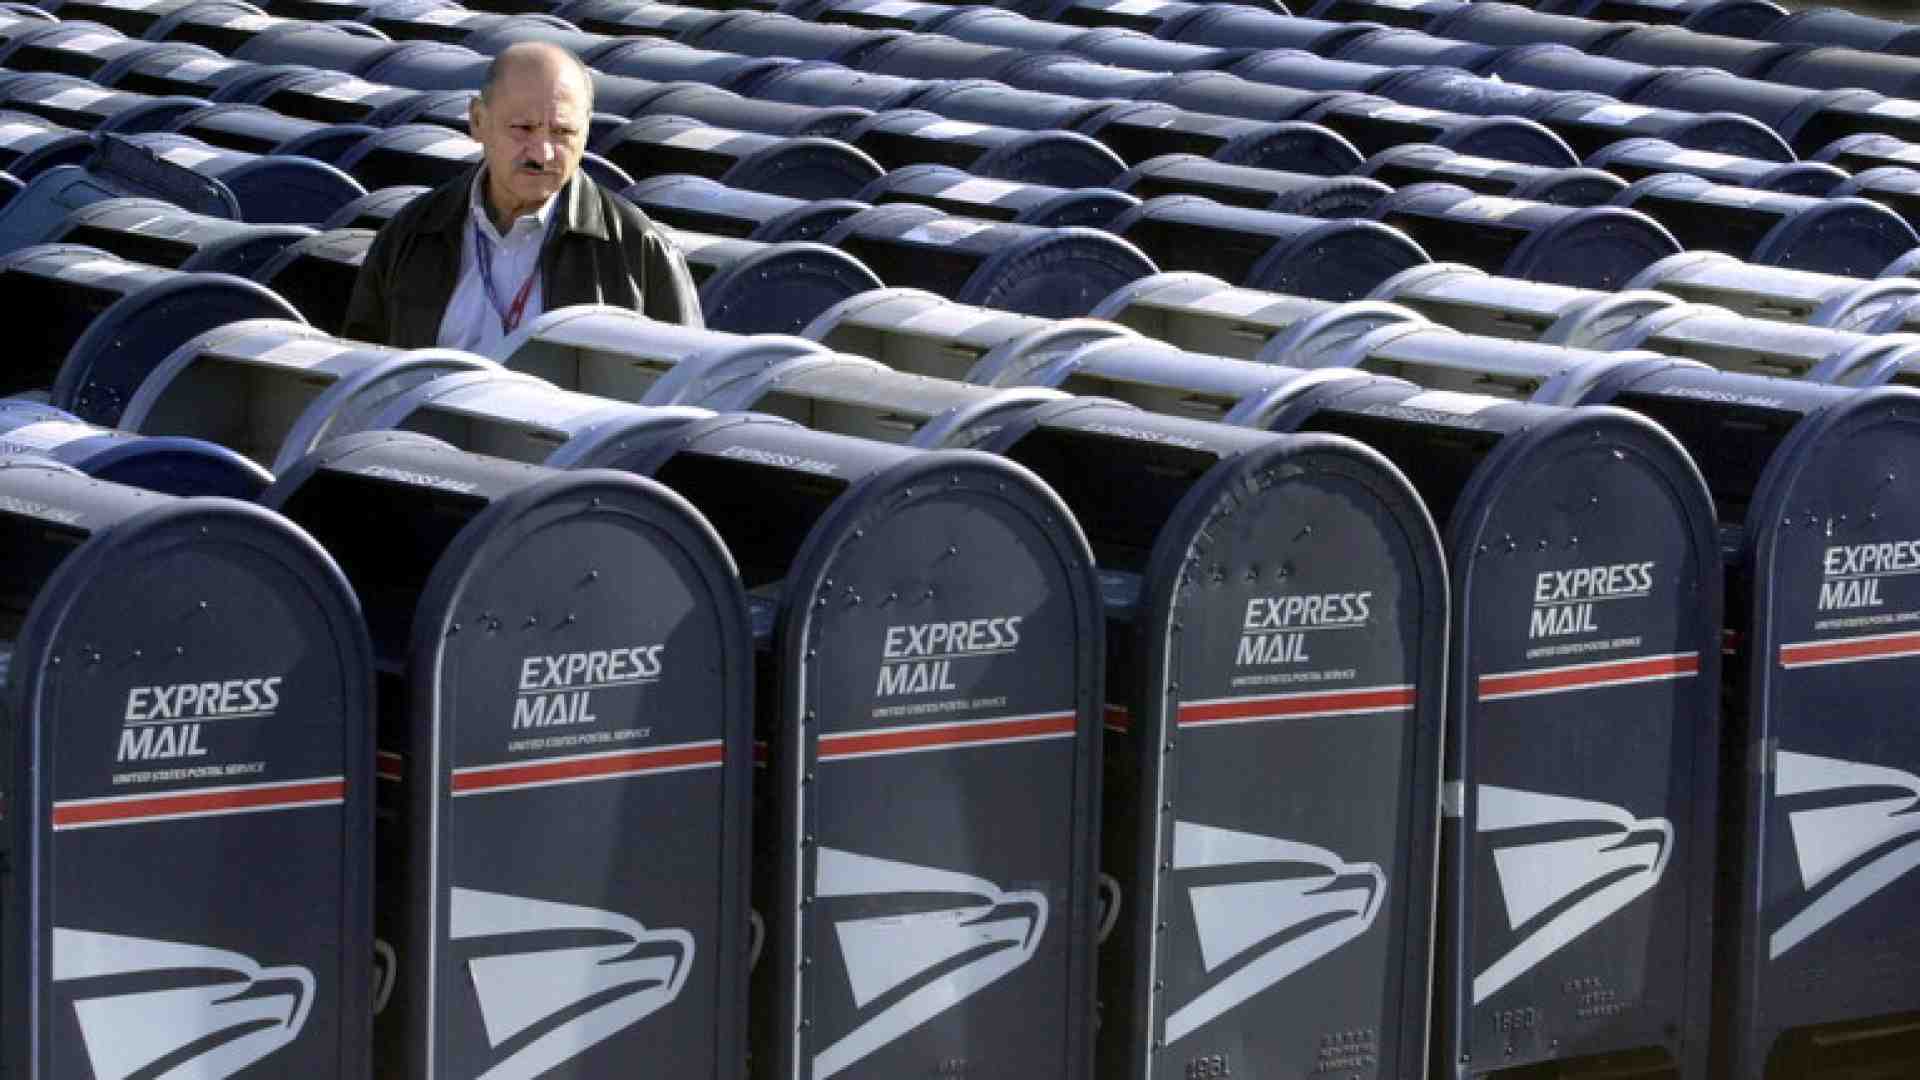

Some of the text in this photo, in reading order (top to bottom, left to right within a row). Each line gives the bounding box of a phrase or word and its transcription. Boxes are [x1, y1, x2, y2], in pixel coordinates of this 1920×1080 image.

[1824, 540, 1920, 574] EXPRES
[1534, 561, 1656, 601] EXPRESS
[1818, 578, 1883, 611] MAIL
[1244, 591, 1372, 628] EXPRESS
[1529, 603, 1598, 639] MAIL
[884, 615, 1024, 657] EXPRESS
[1235, 633, 1309, 665] MAIL
[519, 644, 664, 689] EXPRESS
[877, 661, 956, 696] MAIL
[125, 676, 282, 720] EXPRESS
[512, 691, 596, 730] MAIL
[117, 724, 208, 762] MAIL
